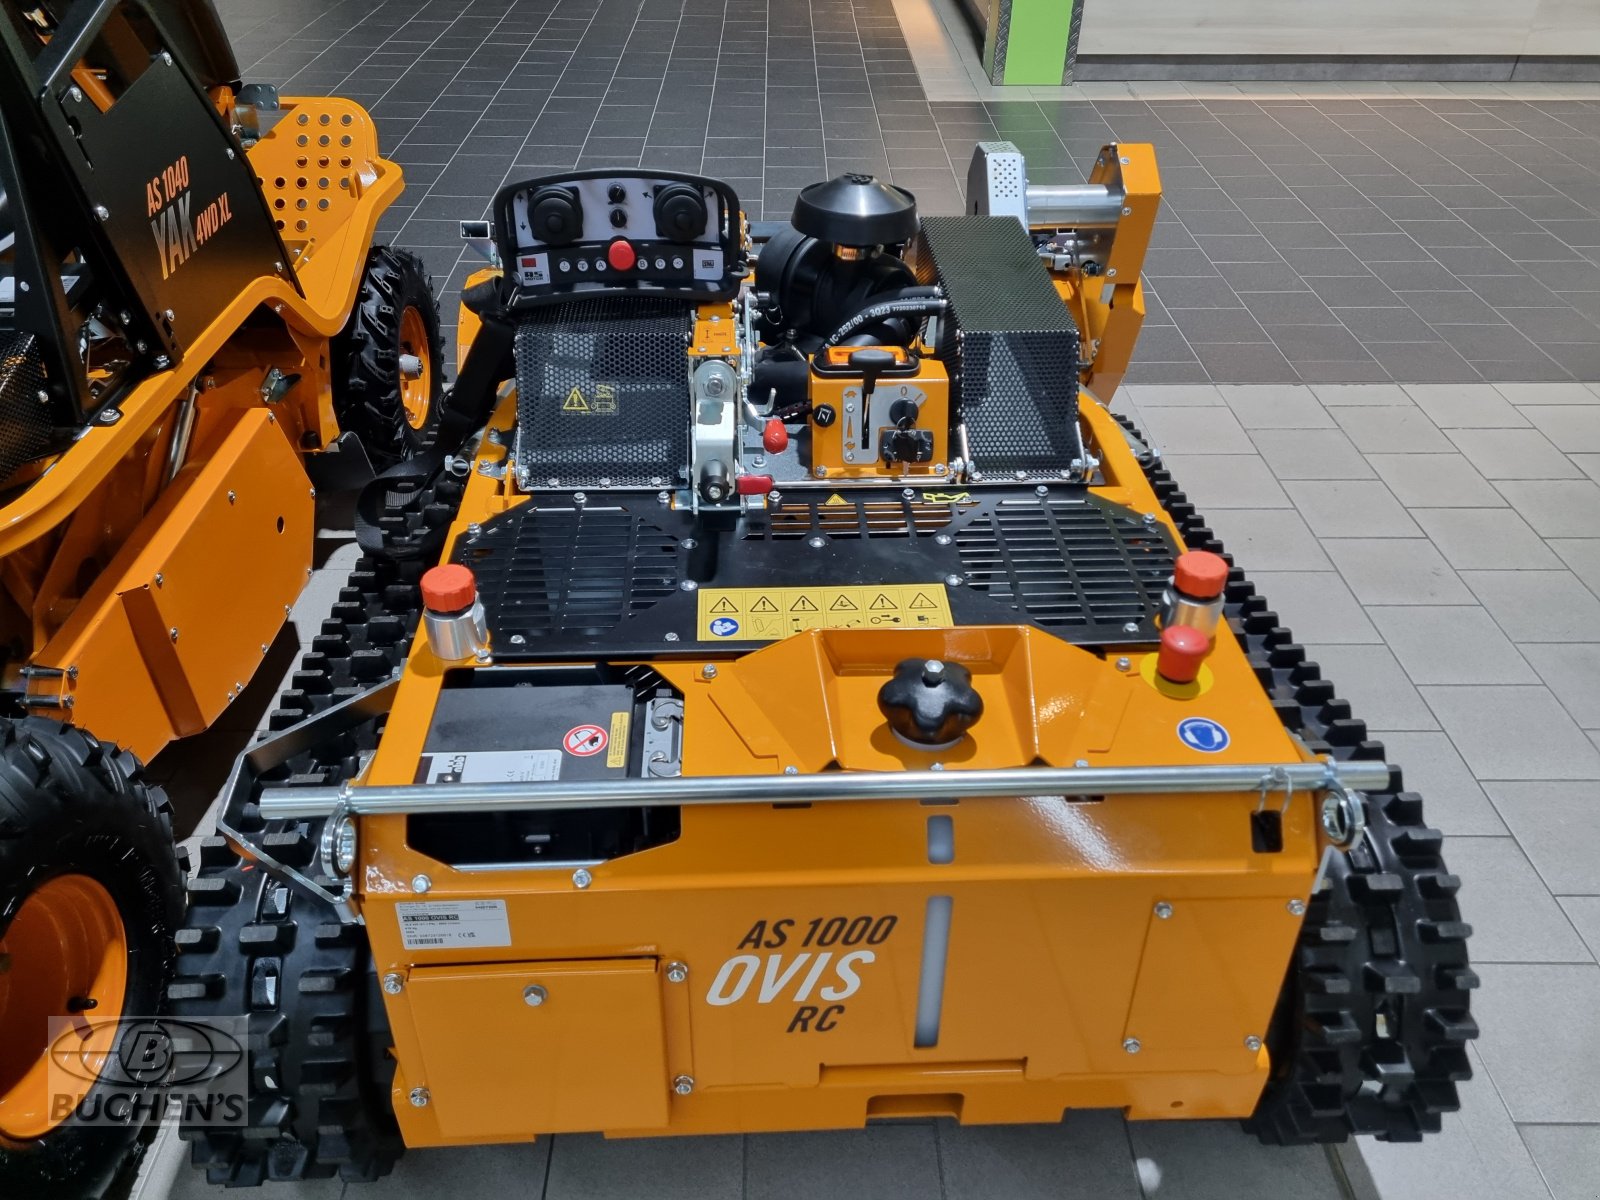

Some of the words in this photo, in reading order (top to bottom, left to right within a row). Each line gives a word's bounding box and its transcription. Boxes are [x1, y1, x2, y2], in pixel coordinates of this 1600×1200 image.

[146, 177, 163, 217] AS
[162, 155, 189, 202] 1040
[151, 190, 198, 280] YAK
[196, 202, 219, 245] 4WD
[218, 192, 232, 226] XL
[736, 919, 795, 950] AS
[801, 915, 898, 947] 1000
[706, 950, 875, 1006] OVIS
[786, 1005, 845, 1033] RC
